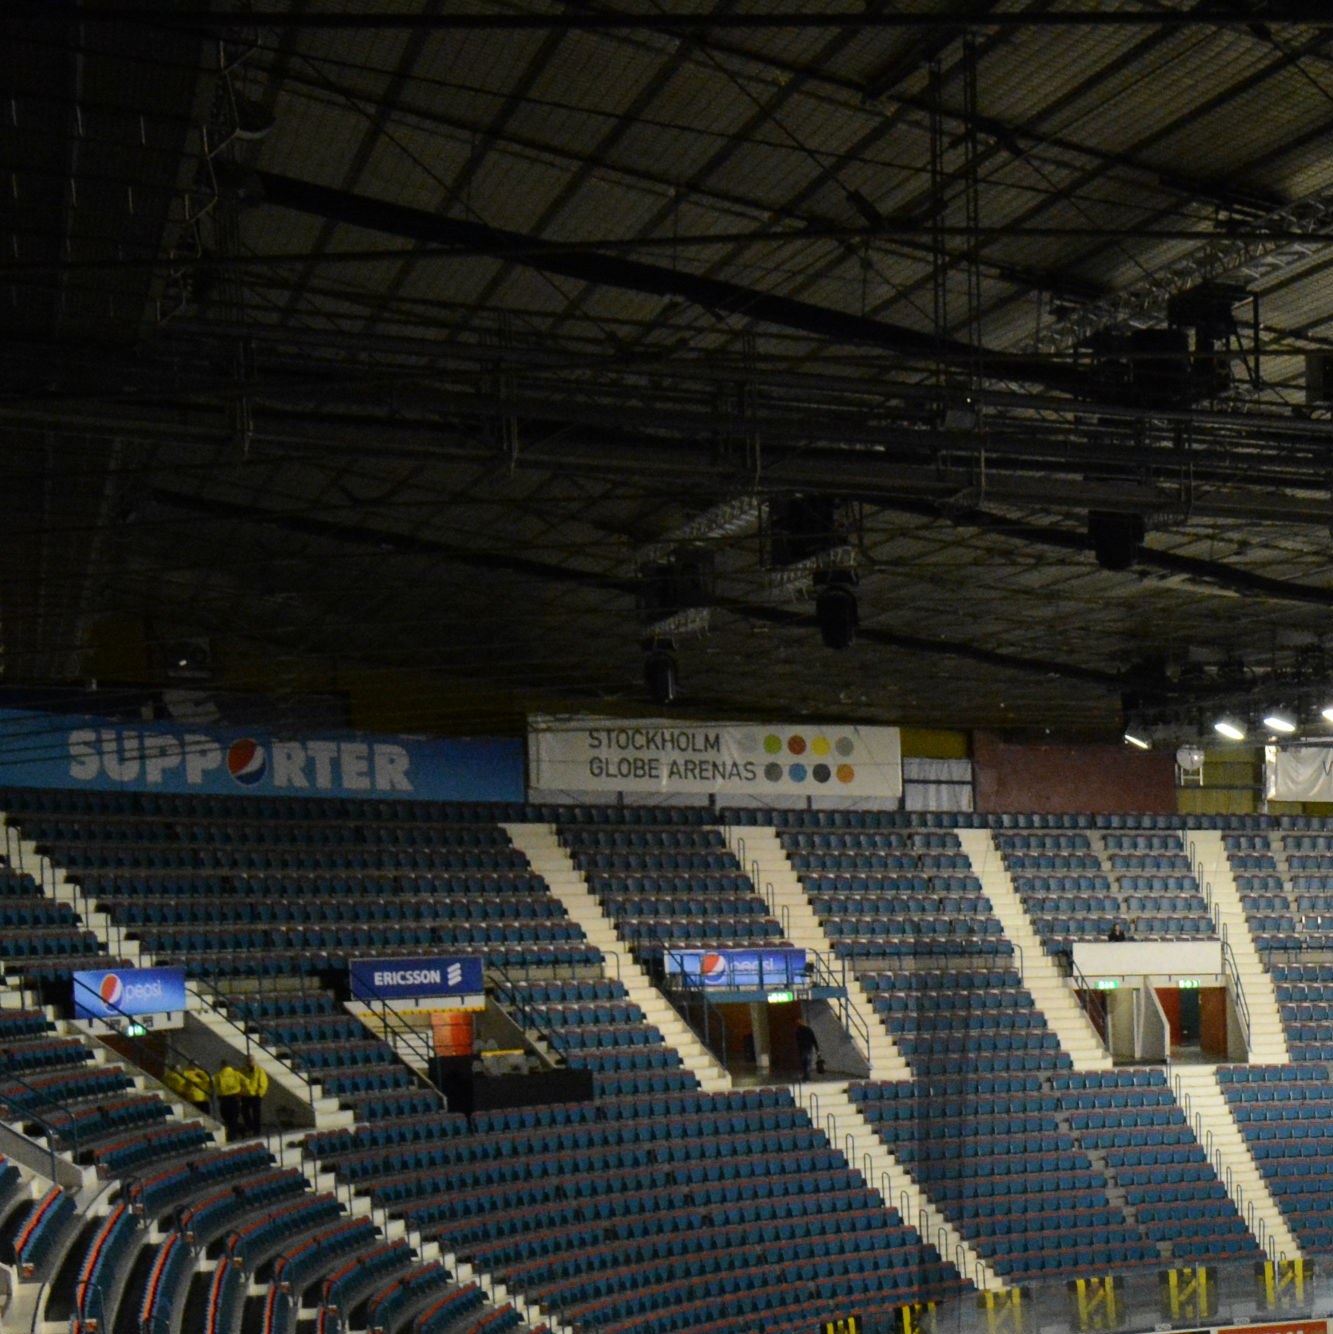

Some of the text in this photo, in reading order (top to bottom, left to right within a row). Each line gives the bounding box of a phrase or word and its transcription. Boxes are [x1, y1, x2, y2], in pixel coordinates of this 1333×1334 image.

[589, 729, 721, 753] STOCKHOLM
[590, 758, 757, 781] GLOBE ARENAS
[374, 970, 441, 986] ERICSSON
[125, 980, 162, 1002] pepsi
